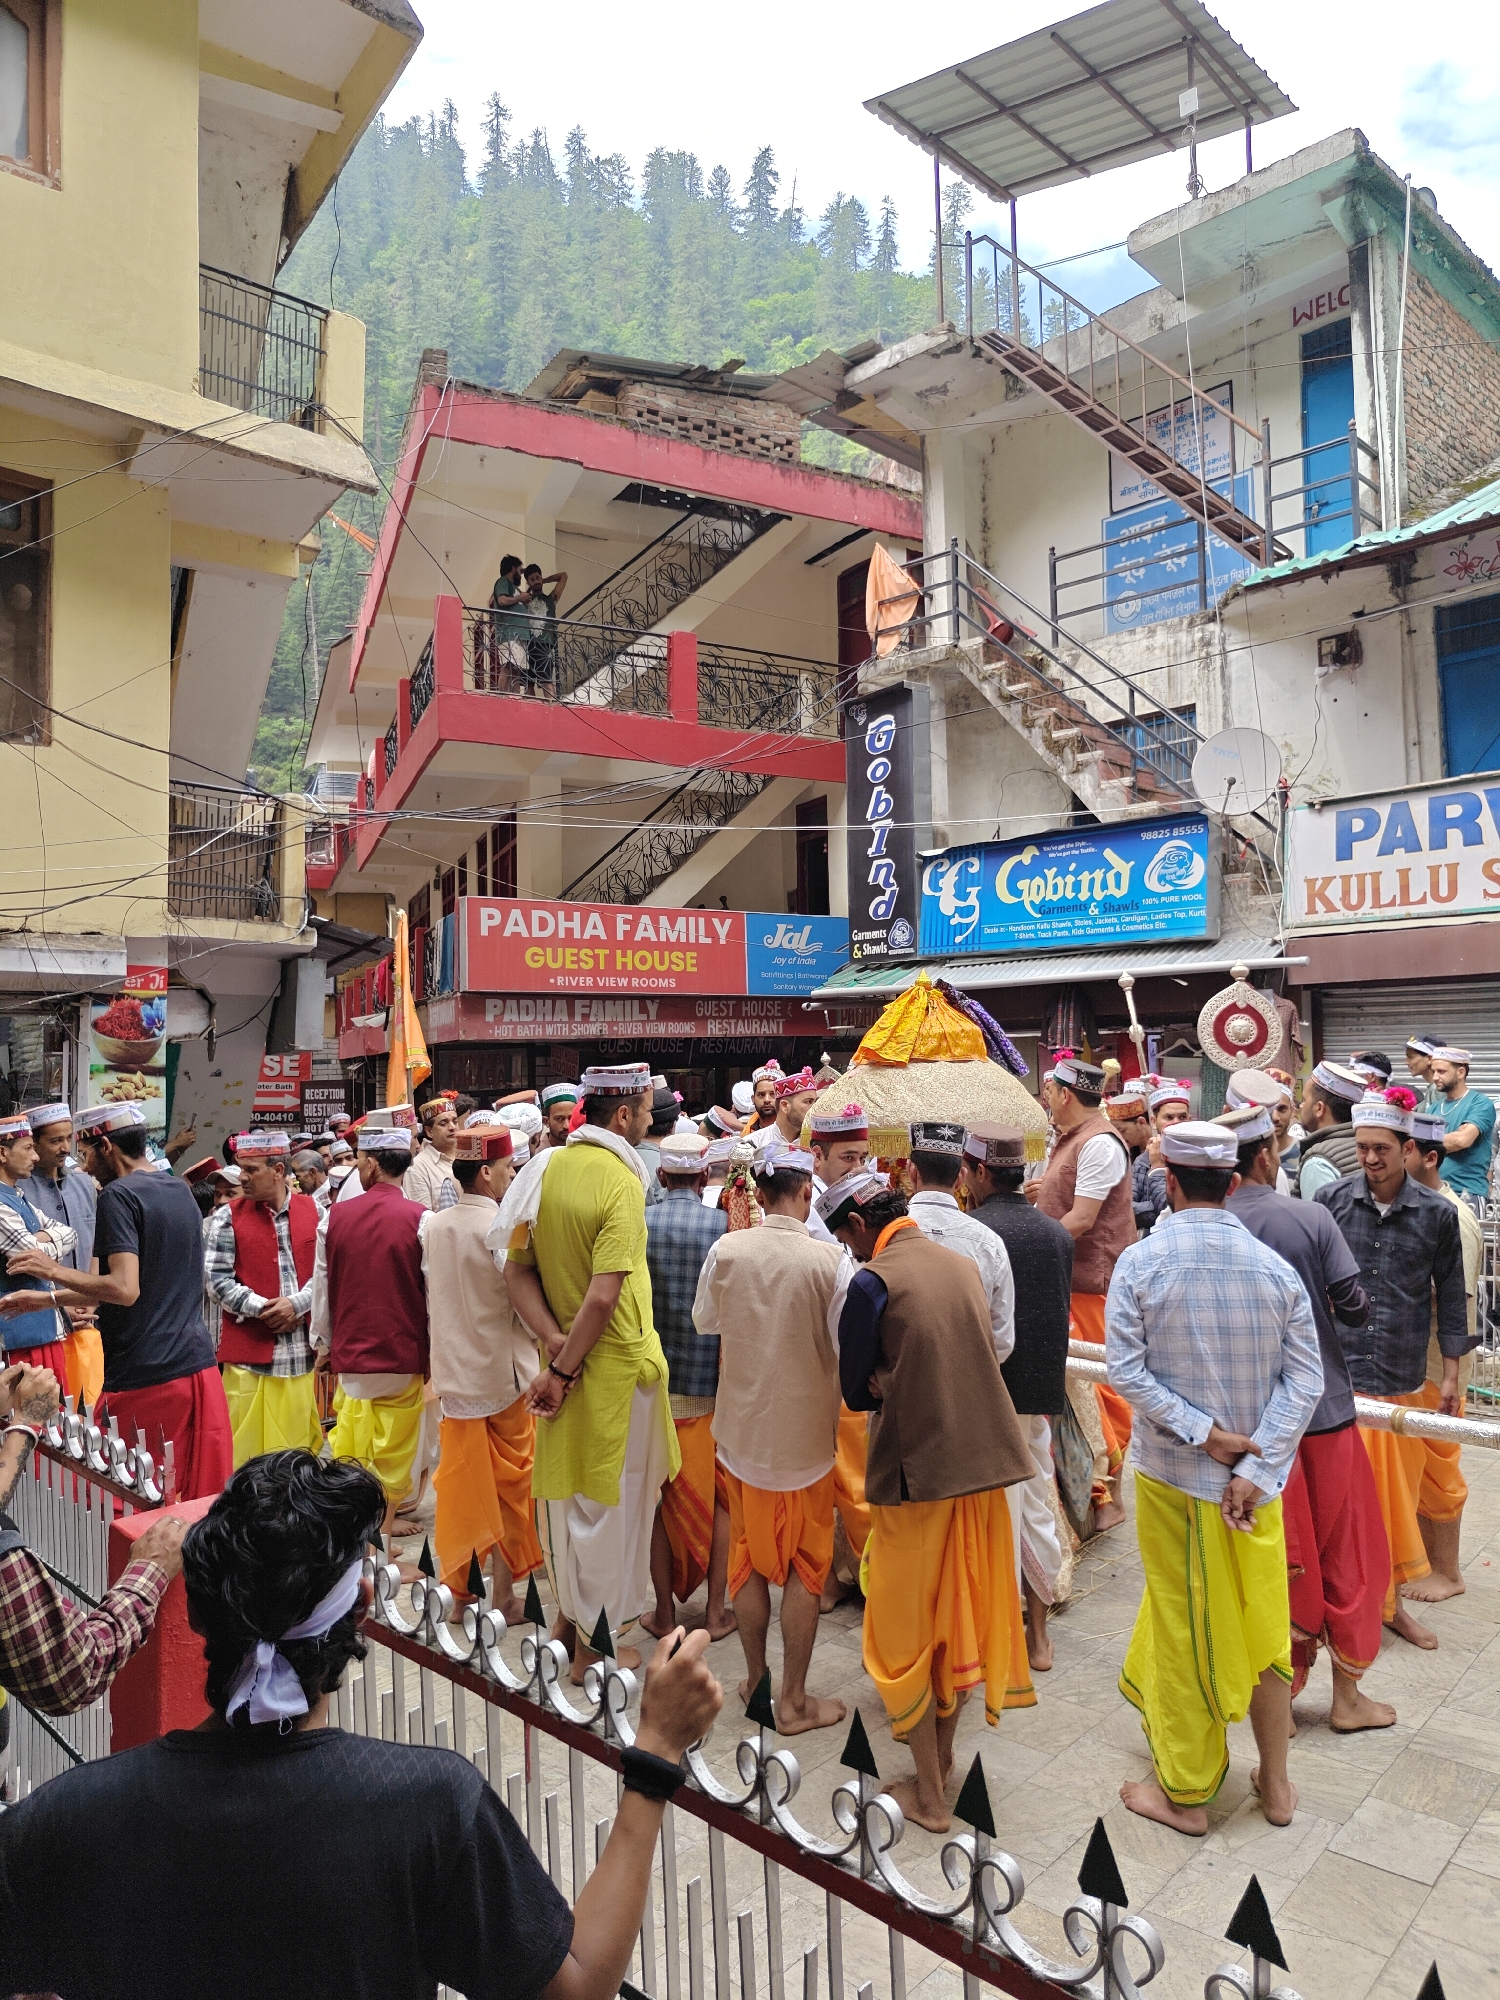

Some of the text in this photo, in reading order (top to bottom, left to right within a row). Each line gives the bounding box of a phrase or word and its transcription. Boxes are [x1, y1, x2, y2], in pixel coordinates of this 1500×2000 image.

[1141, 824, 1204, 841] 98825 85555
[995, 845, 1135, 918] Gobind
[1304, 862, 1460, 915] KULLU
[1142, 893, 1204, 905] 100% PURE WOOL
[1039, 900, 1139, 916] Garments & Shawls
[480, 907, 732, 945] PADHA FAMILY
[984, 926, 999, 934] Deals
[1151, 912, 1171, 920] Ladies
[1086, 926, 1114, 934] Garments
[852, 928, 887, 941] Garments
[852, 943, 862, 958] &
[862, 942, 888, 956] Shawls
[525, 946, 697, 973] GUEST HOUSE
[772, 956, 816, 967] Joy of India
[557, 976, 676, 988] RIVER VIEW ROOMS
[485, 999, 569, 1022] PADHA
[574, 999, 660, 1021] FAMILY
[695, 1001, 739, 1017] GUEST
[742, 1001, 782, 1017] HOUSE
[494, 1018, 785, 1037] HOT BATH WITH SHOWER RIVER VIEW ROOMS RESTAURANT
[598, 1037, 774, 1055] GUEST HOUSE RESTAURANT
[552, 1060, 576, 1079] ROOMS
[305, 1088, 345, 1100] RECEPTION
